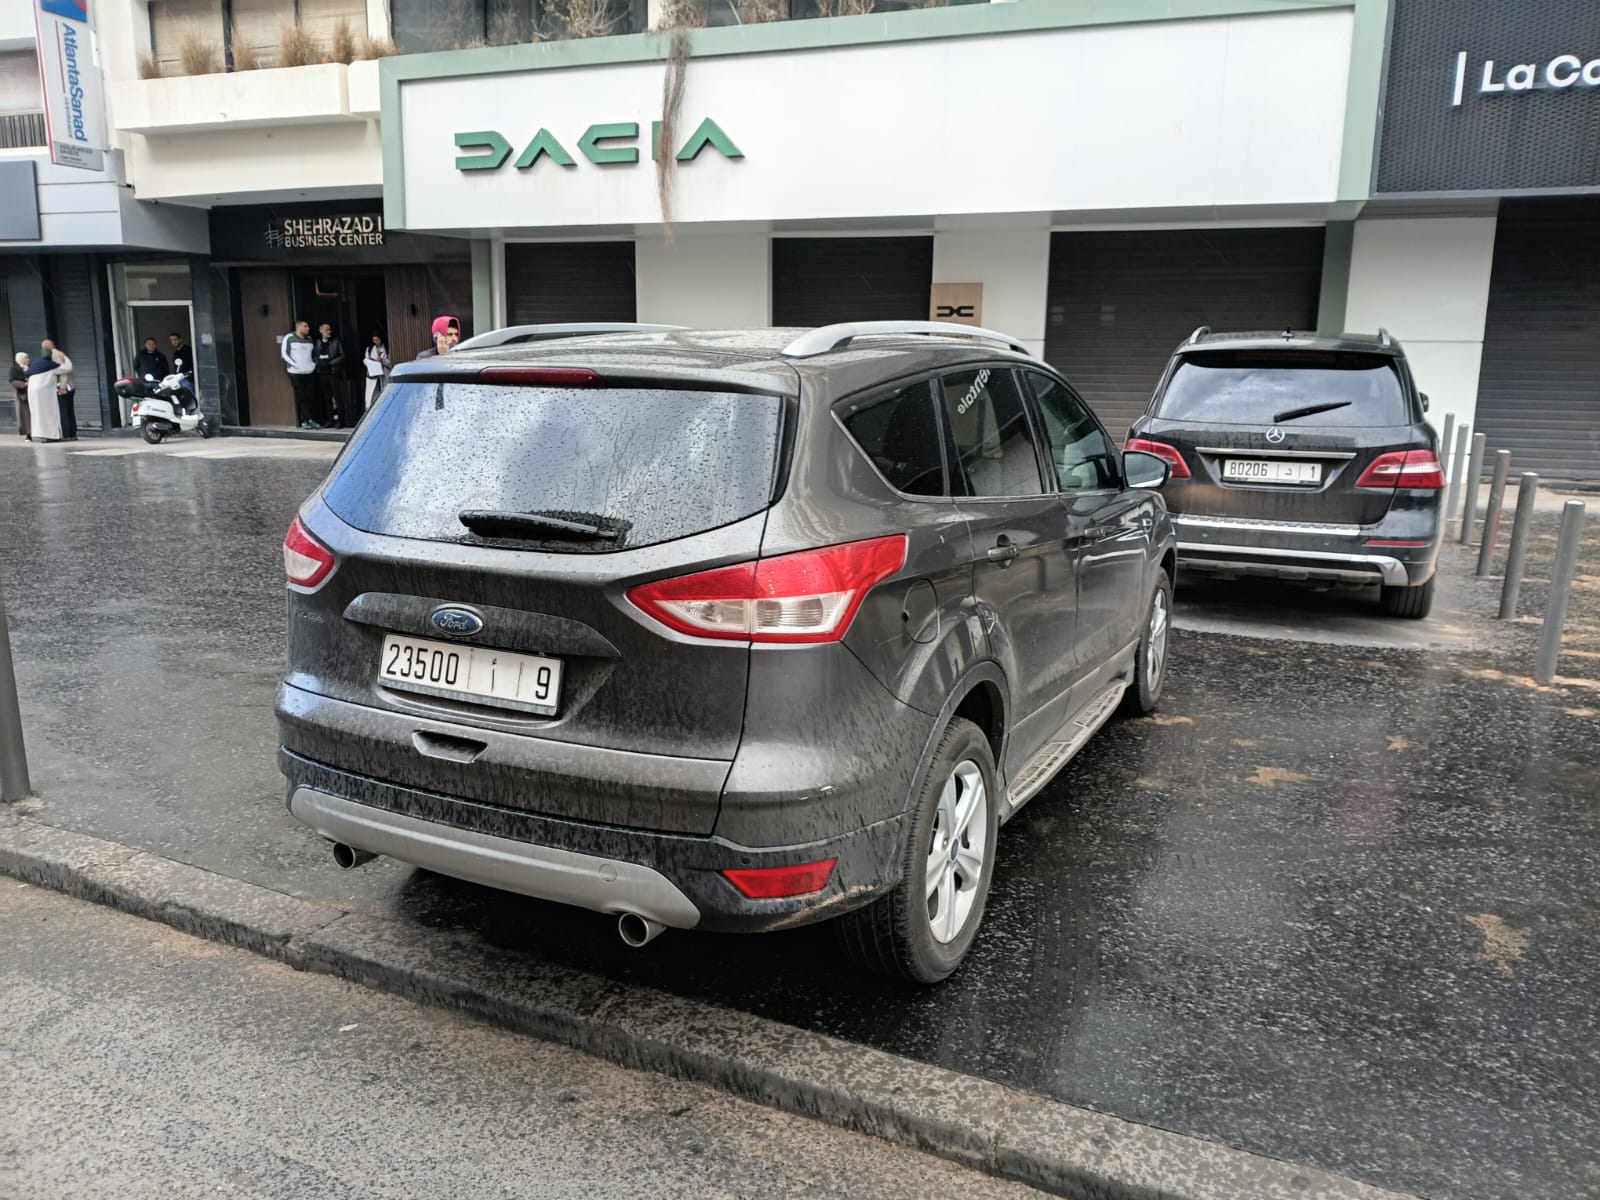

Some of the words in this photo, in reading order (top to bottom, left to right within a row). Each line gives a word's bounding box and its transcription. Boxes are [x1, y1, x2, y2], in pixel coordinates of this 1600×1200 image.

[62, 22, 88, 142] AtlantaSanad
[1481, 60, 1536, 91] La
[284, 216, 374, 236] SHEHRAZAD
[284, 235, 336, 248] BUSINESS
[338, 233, 384, 246] CENTER
[1230, 462, 1269, 477] 80206
[1311, 465, 1316, 479] 1
[439, 613, 468, 630] Ford
[386, 643, 460, 686] 23500
[535, 666, 551, 700] 9
